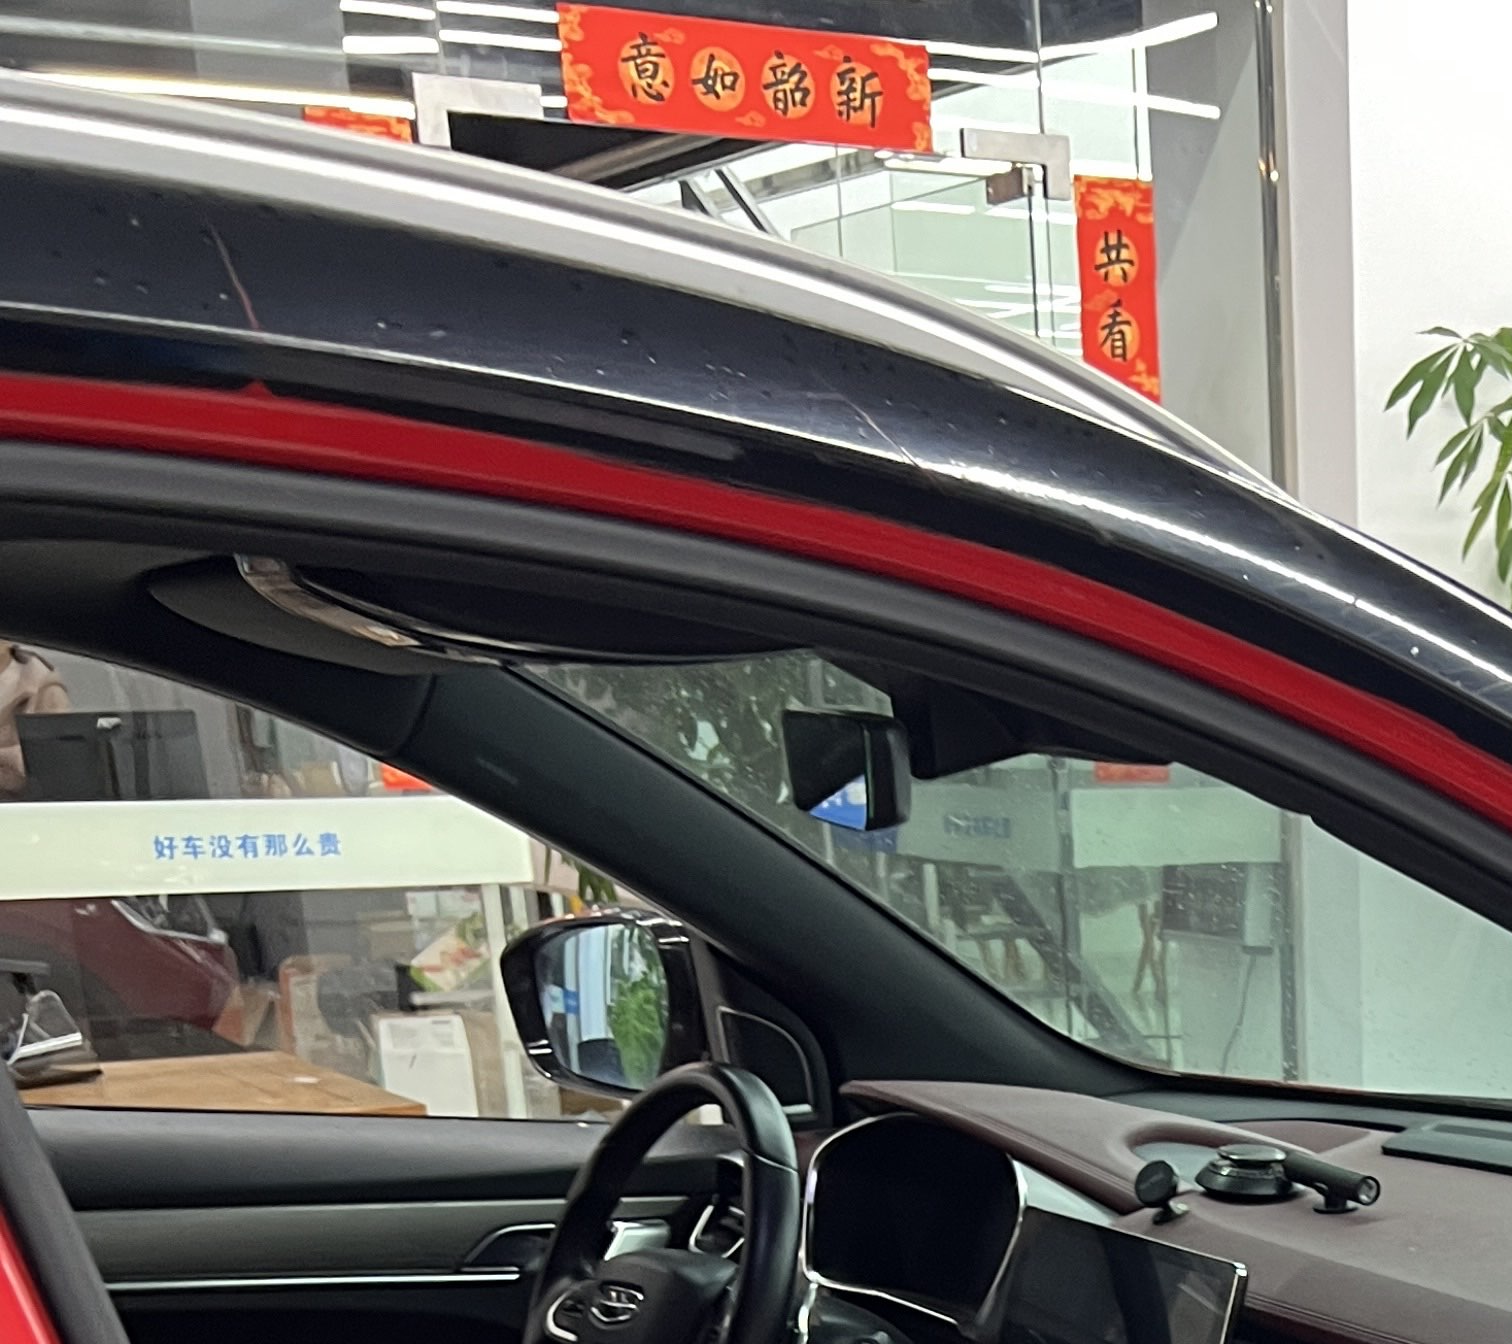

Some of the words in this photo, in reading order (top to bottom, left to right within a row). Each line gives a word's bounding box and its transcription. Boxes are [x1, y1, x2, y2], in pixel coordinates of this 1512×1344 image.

[153, 832, 342, 860] 好车没有那么贵
